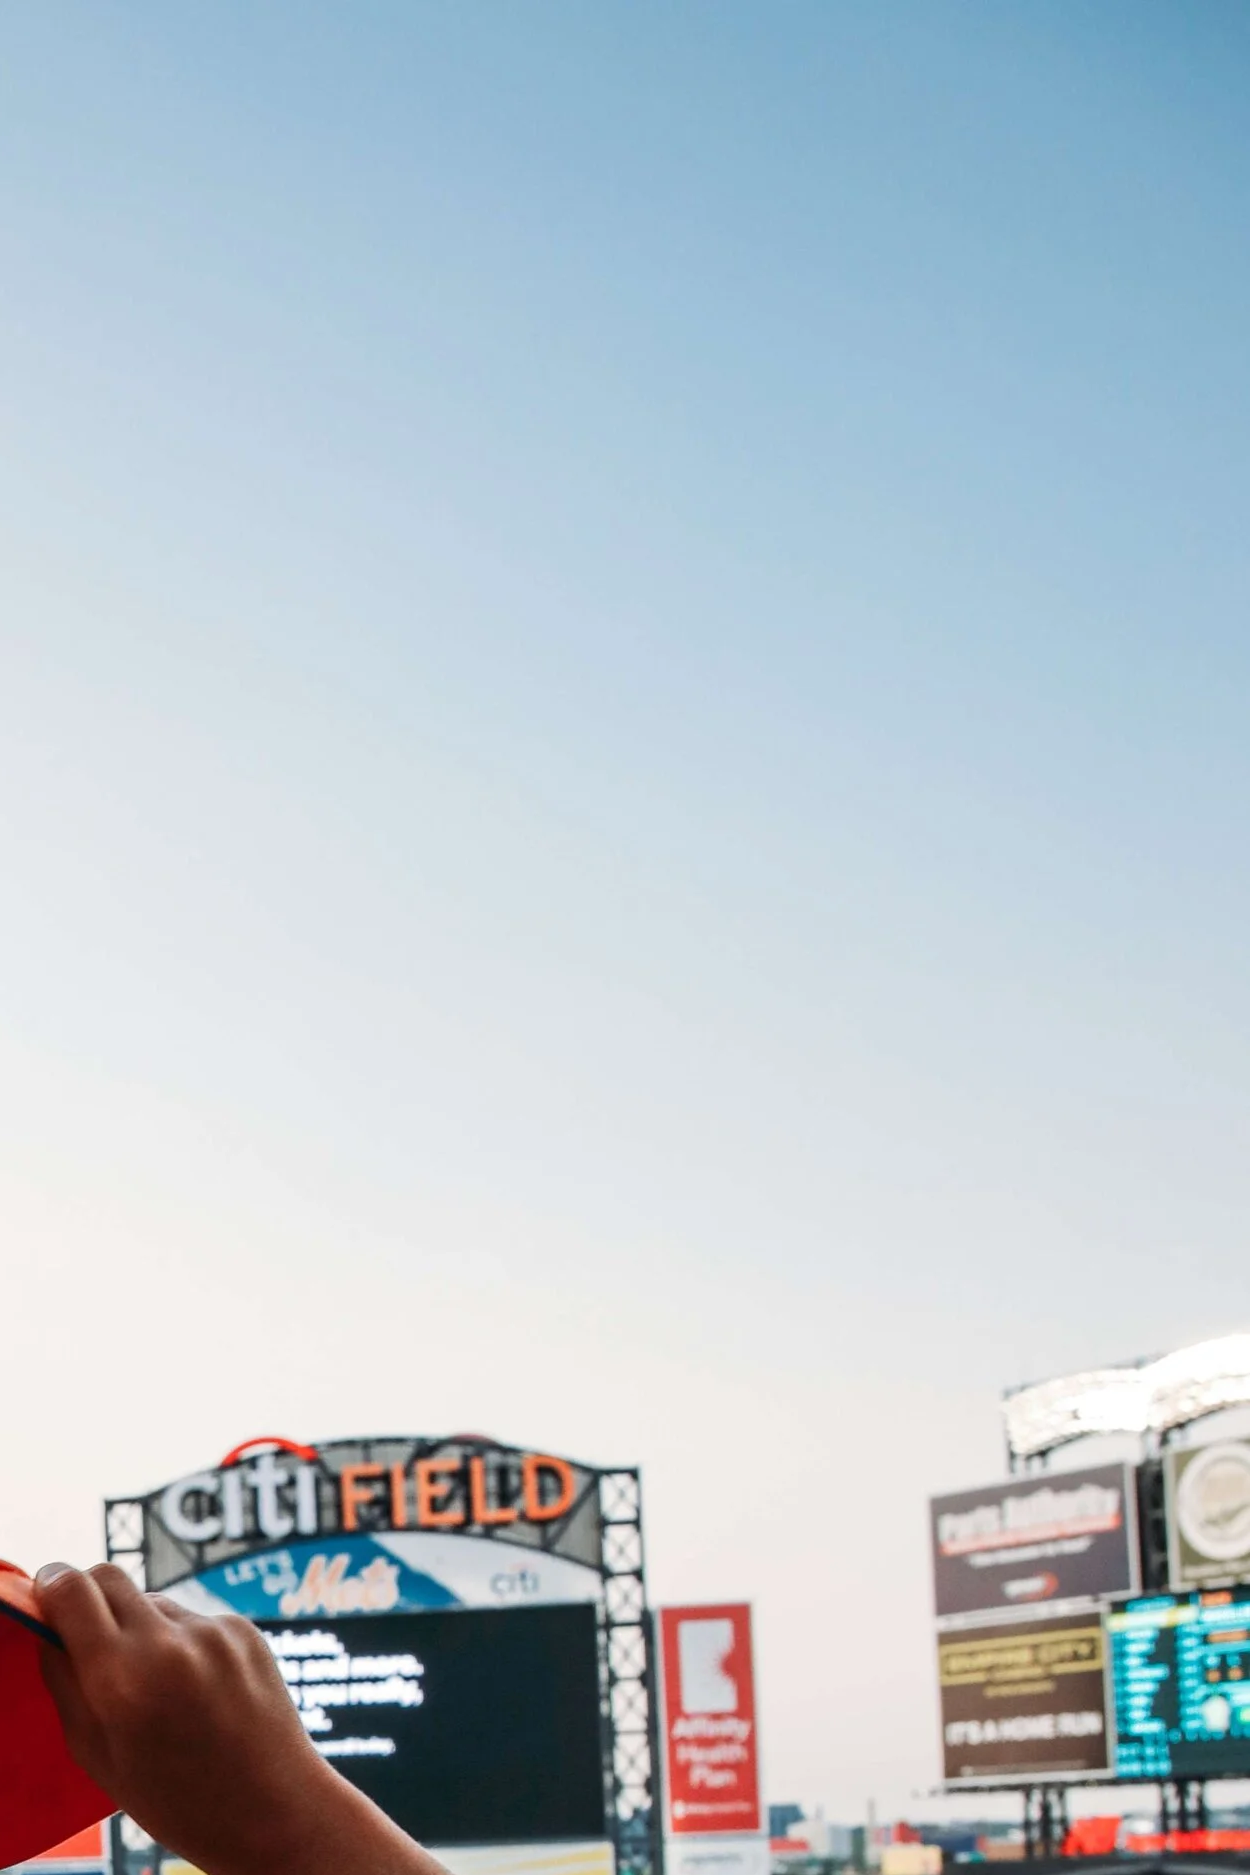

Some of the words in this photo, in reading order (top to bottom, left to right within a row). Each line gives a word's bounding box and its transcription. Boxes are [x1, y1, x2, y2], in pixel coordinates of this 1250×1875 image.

[161, 1451, 319, 1543] citi
[340, 1454, 576, 1533] FIELD
[279, 1553, 402, 1618] Mets
[490, 1563, 541, 1597] citi
[672, 1716, 750, 1742] Affinity
[677, 1744, 747, 1765] Health
[690, 1765, 737, 1790] Plan
